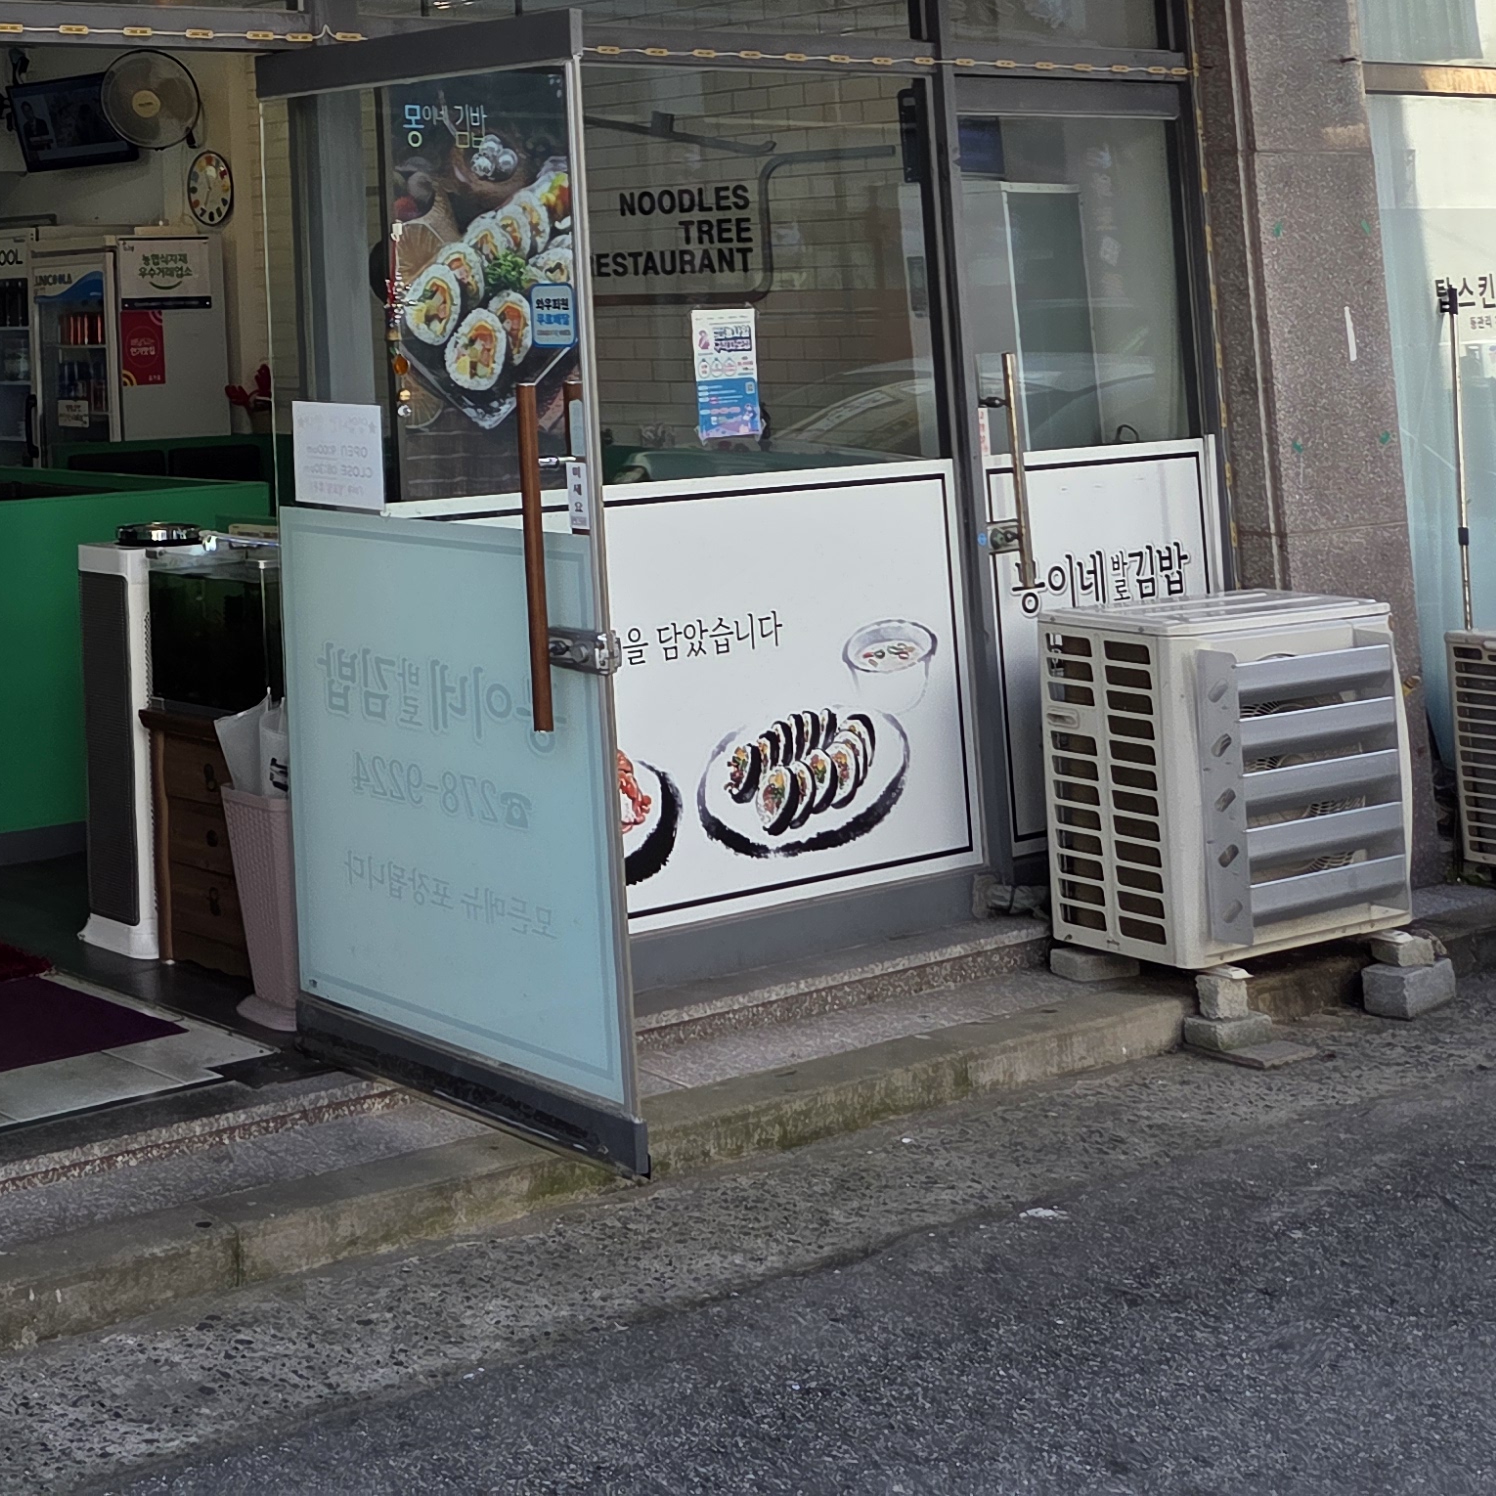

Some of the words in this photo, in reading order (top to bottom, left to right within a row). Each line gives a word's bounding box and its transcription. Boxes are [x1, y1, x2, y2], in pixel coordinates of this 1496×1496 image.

[619, 184, 750, 217] NOODLES
[678, 217, 754, 245] TREE
[591, 247, 754, 277] ESTAURANT
[656, 610, 783, 664] 담았습니다
